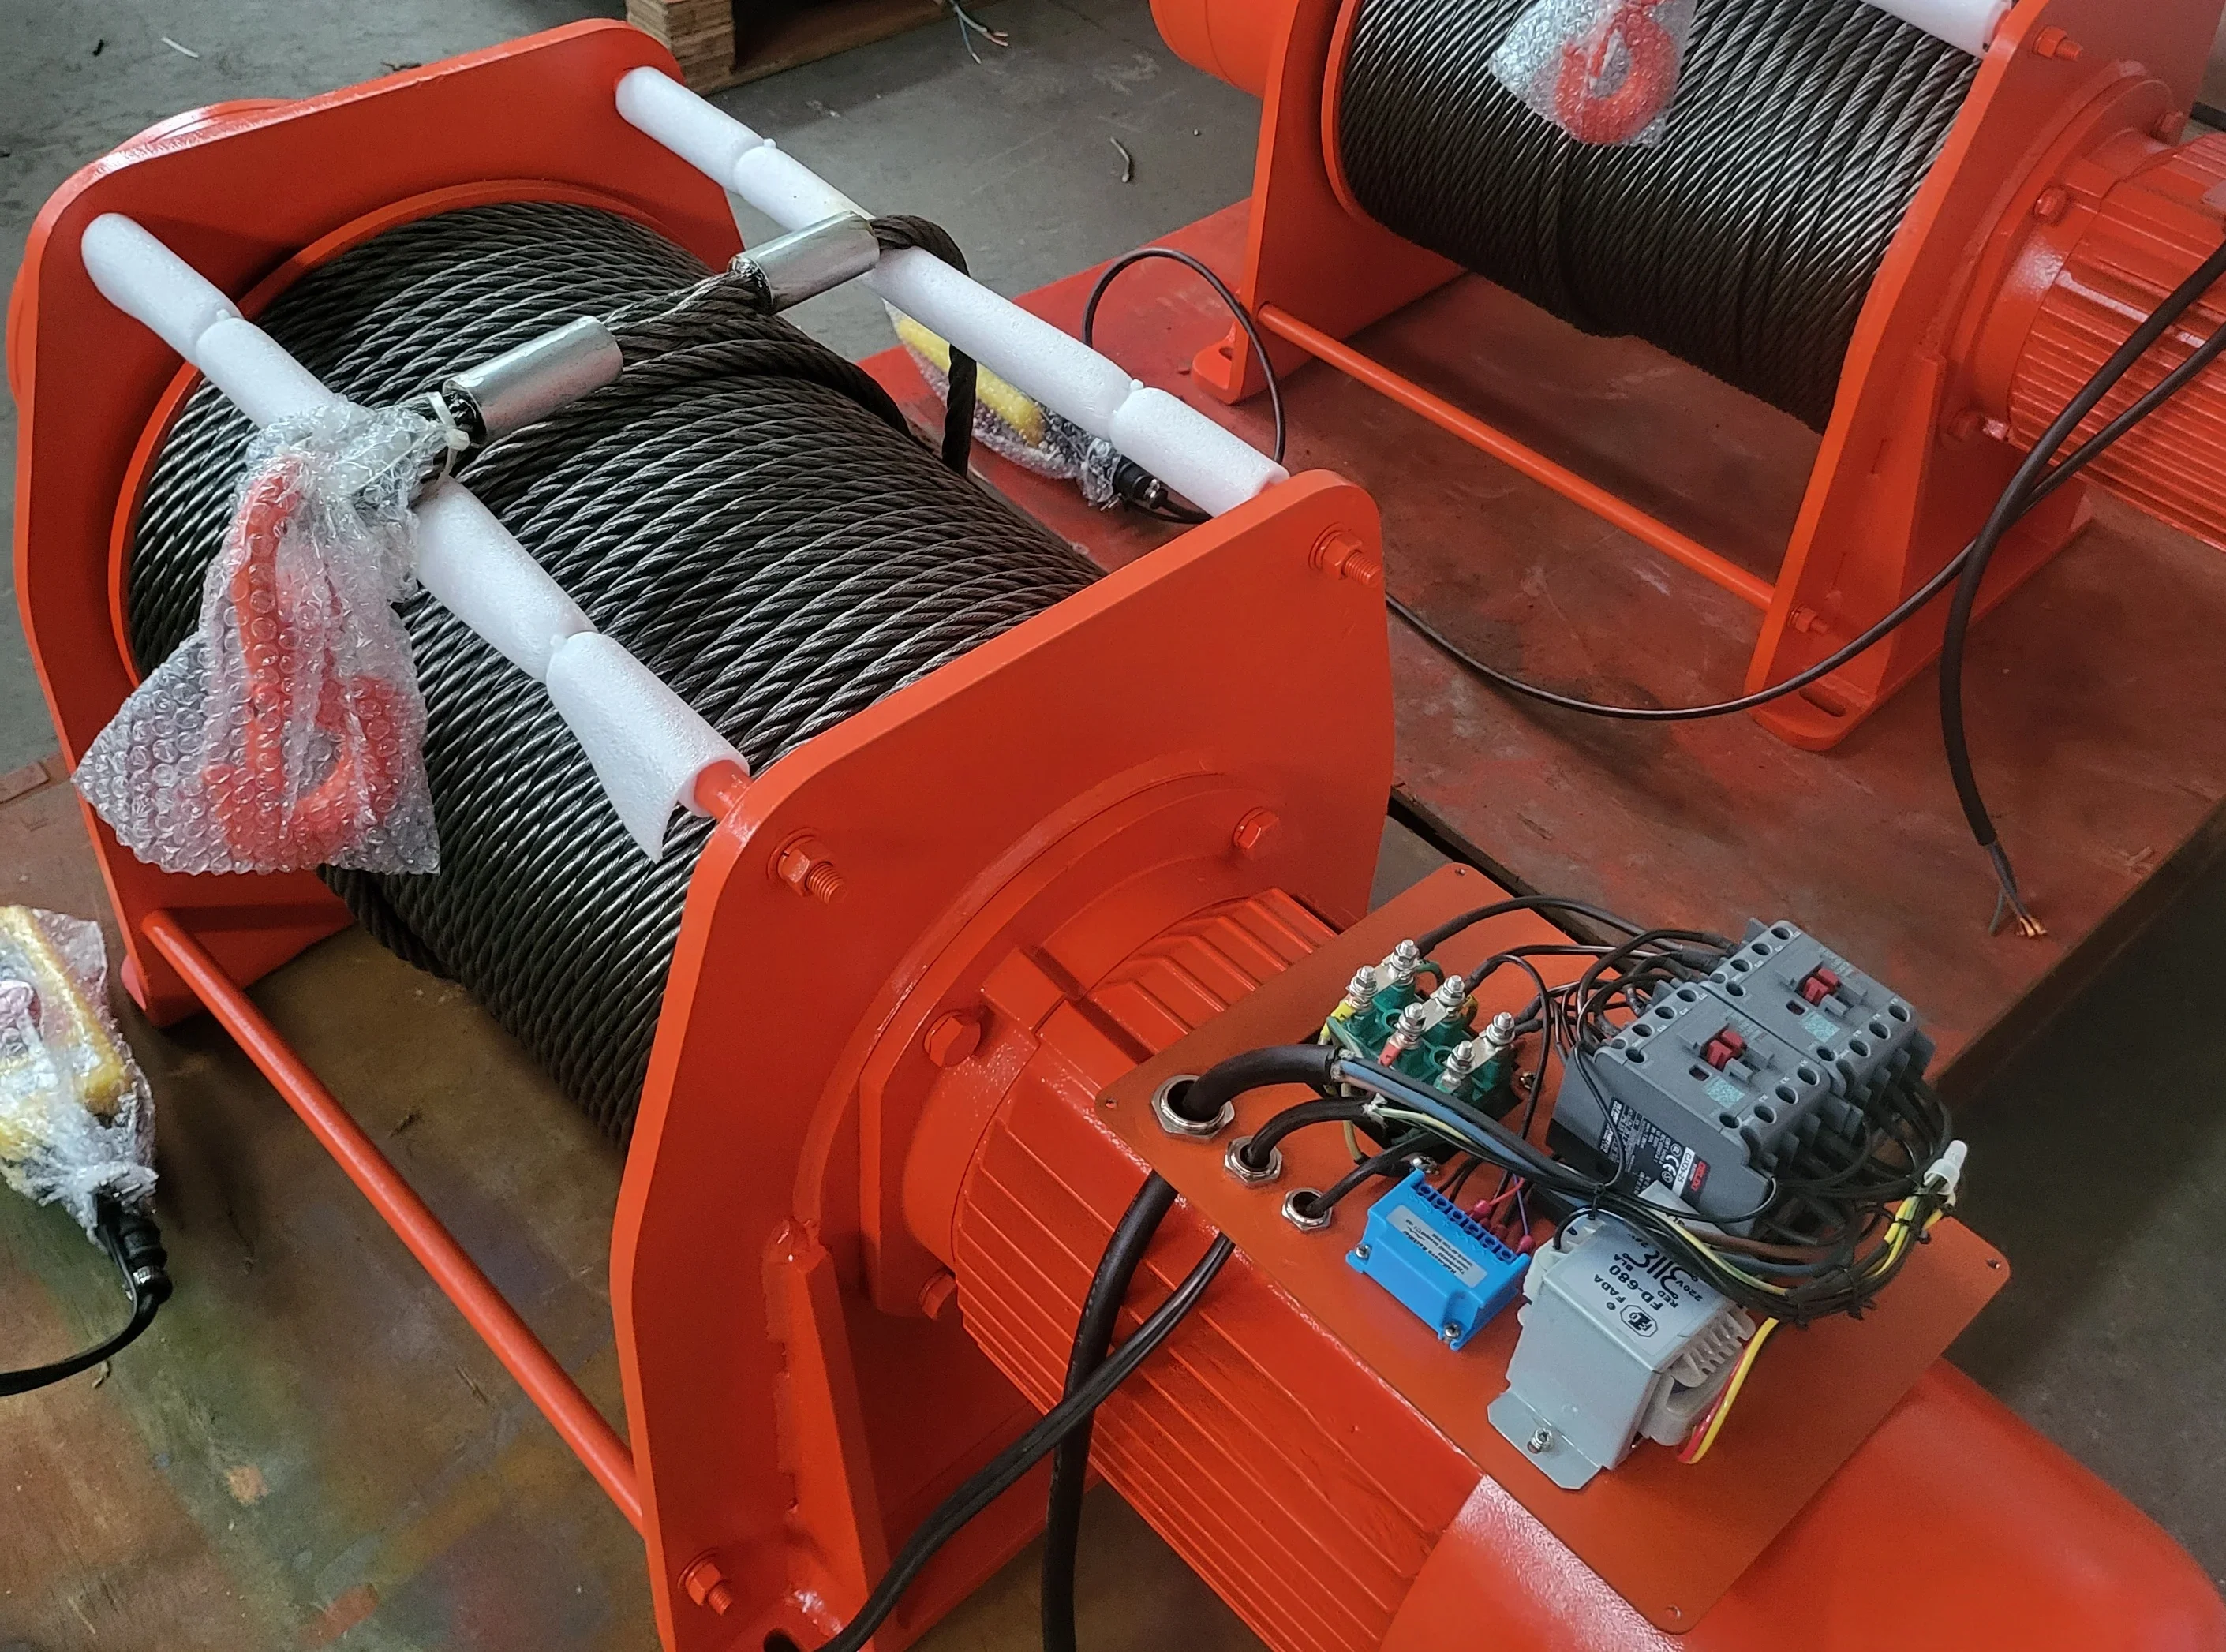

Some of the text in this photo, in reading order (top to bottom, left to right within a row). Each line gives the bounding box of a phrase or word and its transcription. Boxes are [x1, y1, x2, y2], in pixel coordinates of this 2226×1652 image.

[1402, 1230, 1428, 1251] Rectifier
[1427, 1250, 1457, 1275] Half-wave
[1593, 1273, 1627, 1304] FADA
[1609, 1265, 1664, 1311] FD-680
[1657, 1290, 1679, 1309] RED
[1674, 1280, 1704, 1302] 220V
